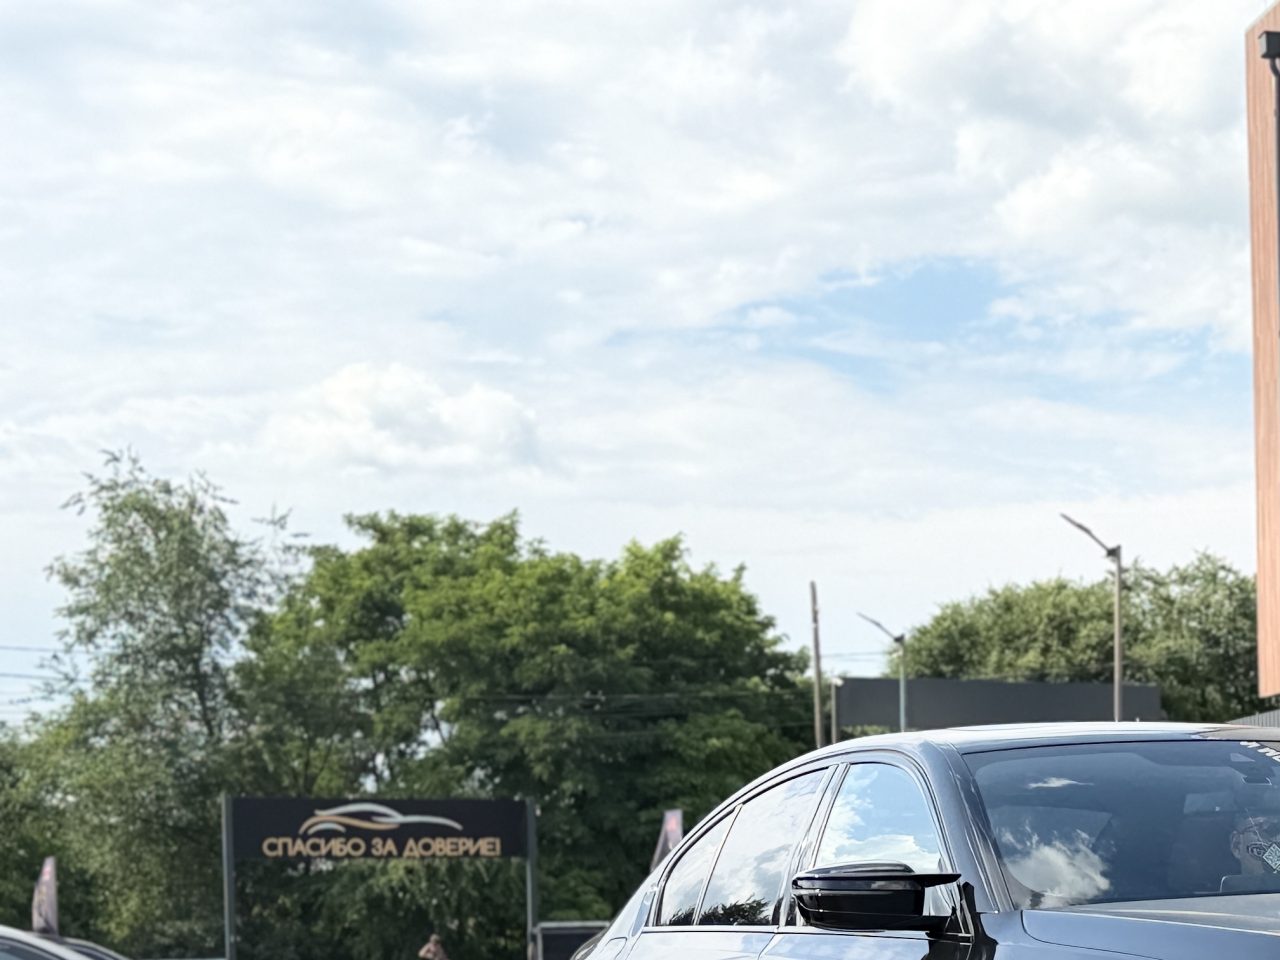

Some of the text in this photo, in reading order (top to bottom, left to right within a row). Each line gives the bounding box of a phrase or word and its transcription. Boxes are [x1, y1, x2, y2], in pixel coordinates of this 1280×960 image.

[262, 837, 501, 858] СПАСИБО ЗА ДОВЕРИЕ!
